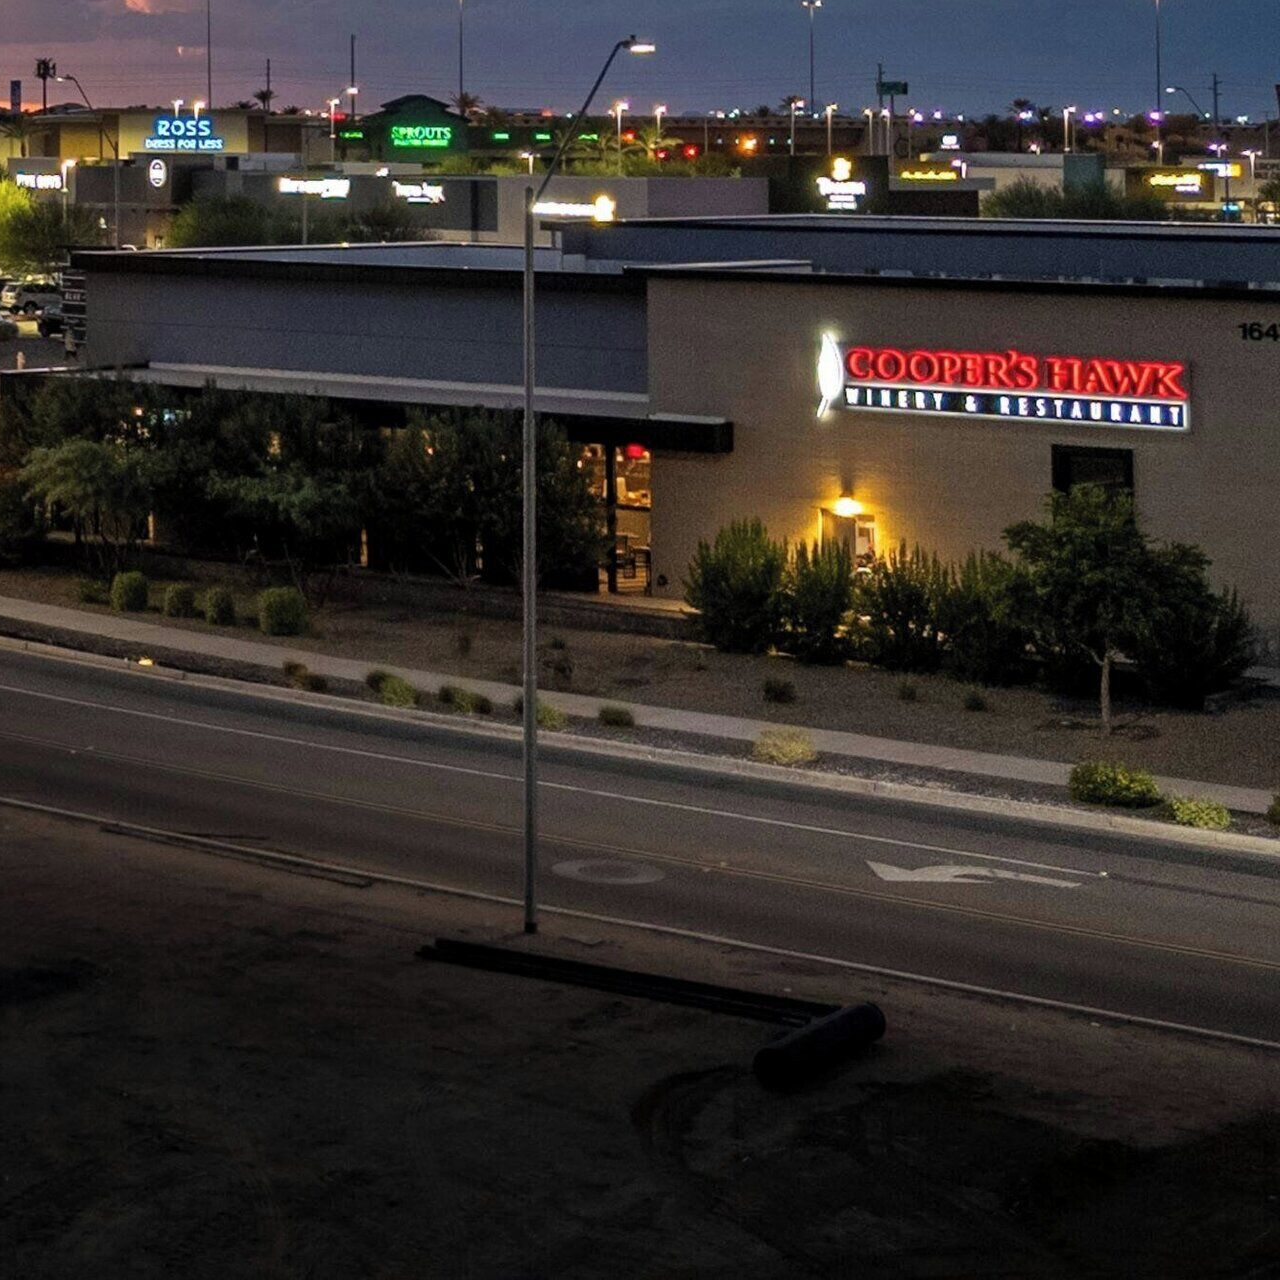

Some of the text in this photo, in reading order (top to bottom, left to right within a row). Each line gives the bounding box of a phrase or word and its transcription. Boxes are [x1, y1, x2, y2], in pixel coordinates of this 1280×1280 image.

[157, 120, 211, 136] ROSS
[391, 127, 451, 140] SPROUTS
[1238, 322, 1280, 341] 164
[847, 348, 1187, 399] COOPER'S HAWK
[845, 387, 1183, 426] WINERY & RESTAURANT
